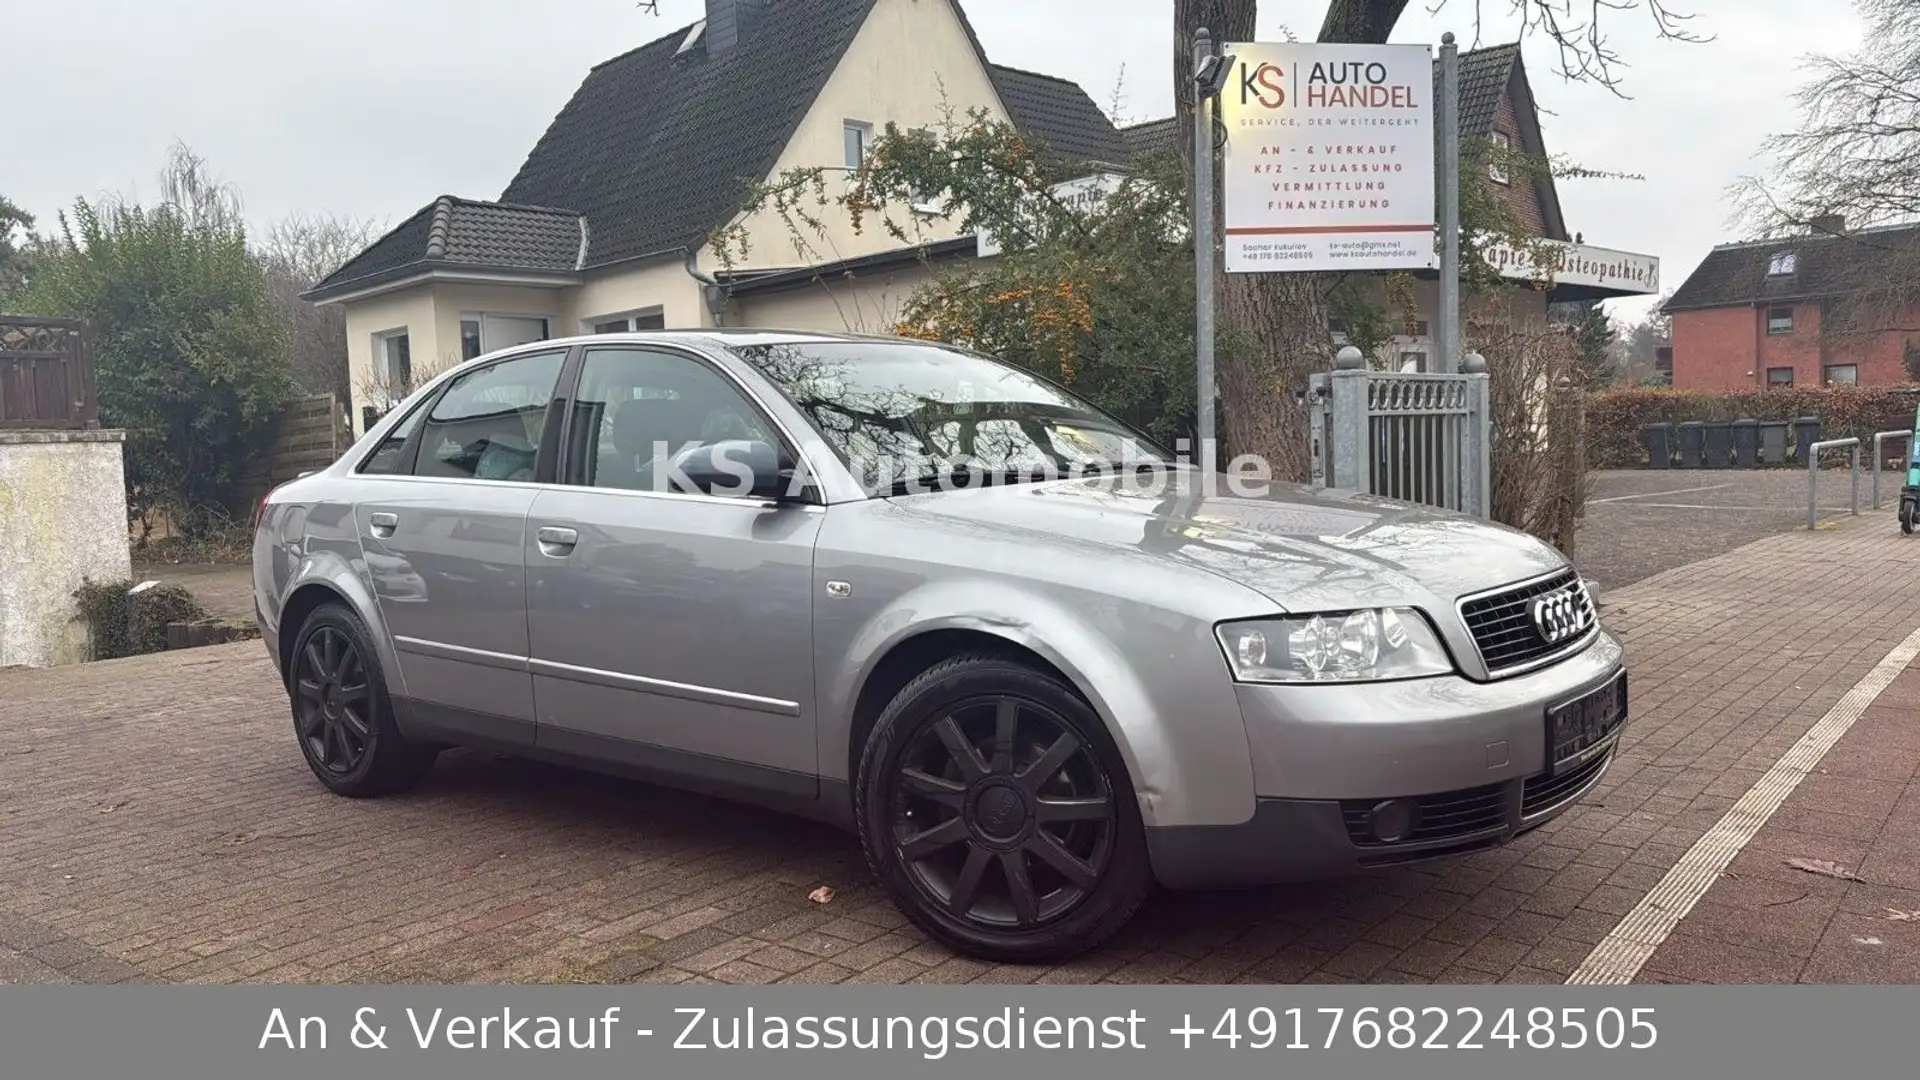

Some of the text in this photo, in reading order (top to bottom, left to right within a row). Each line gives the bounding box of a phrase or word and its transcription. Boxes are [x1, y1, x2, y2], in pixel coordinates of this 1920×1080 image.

[1308, 62, 1387, 85] AUTO
[1241, 62, 1285, 109] KS
[1308, 85, 1418, 108] HANDEL
[1308, 118, 1332, 126] DER
[1340, 118, 1419, 126] WEITERGEHT
[1261, 146, 1280, 155] AN
[1307, 146, 1314, 155] &
[1325, 146, 1397, 154] VERKAUF
[1254, 165, 1284, 174] KFZ
[1309, 163, 1403, 173] ZULASSUNG
[1272, 182, 1386, 192] VERMITTLUNG
[1268, 200, 1390, 210] FINANZIERUNG
